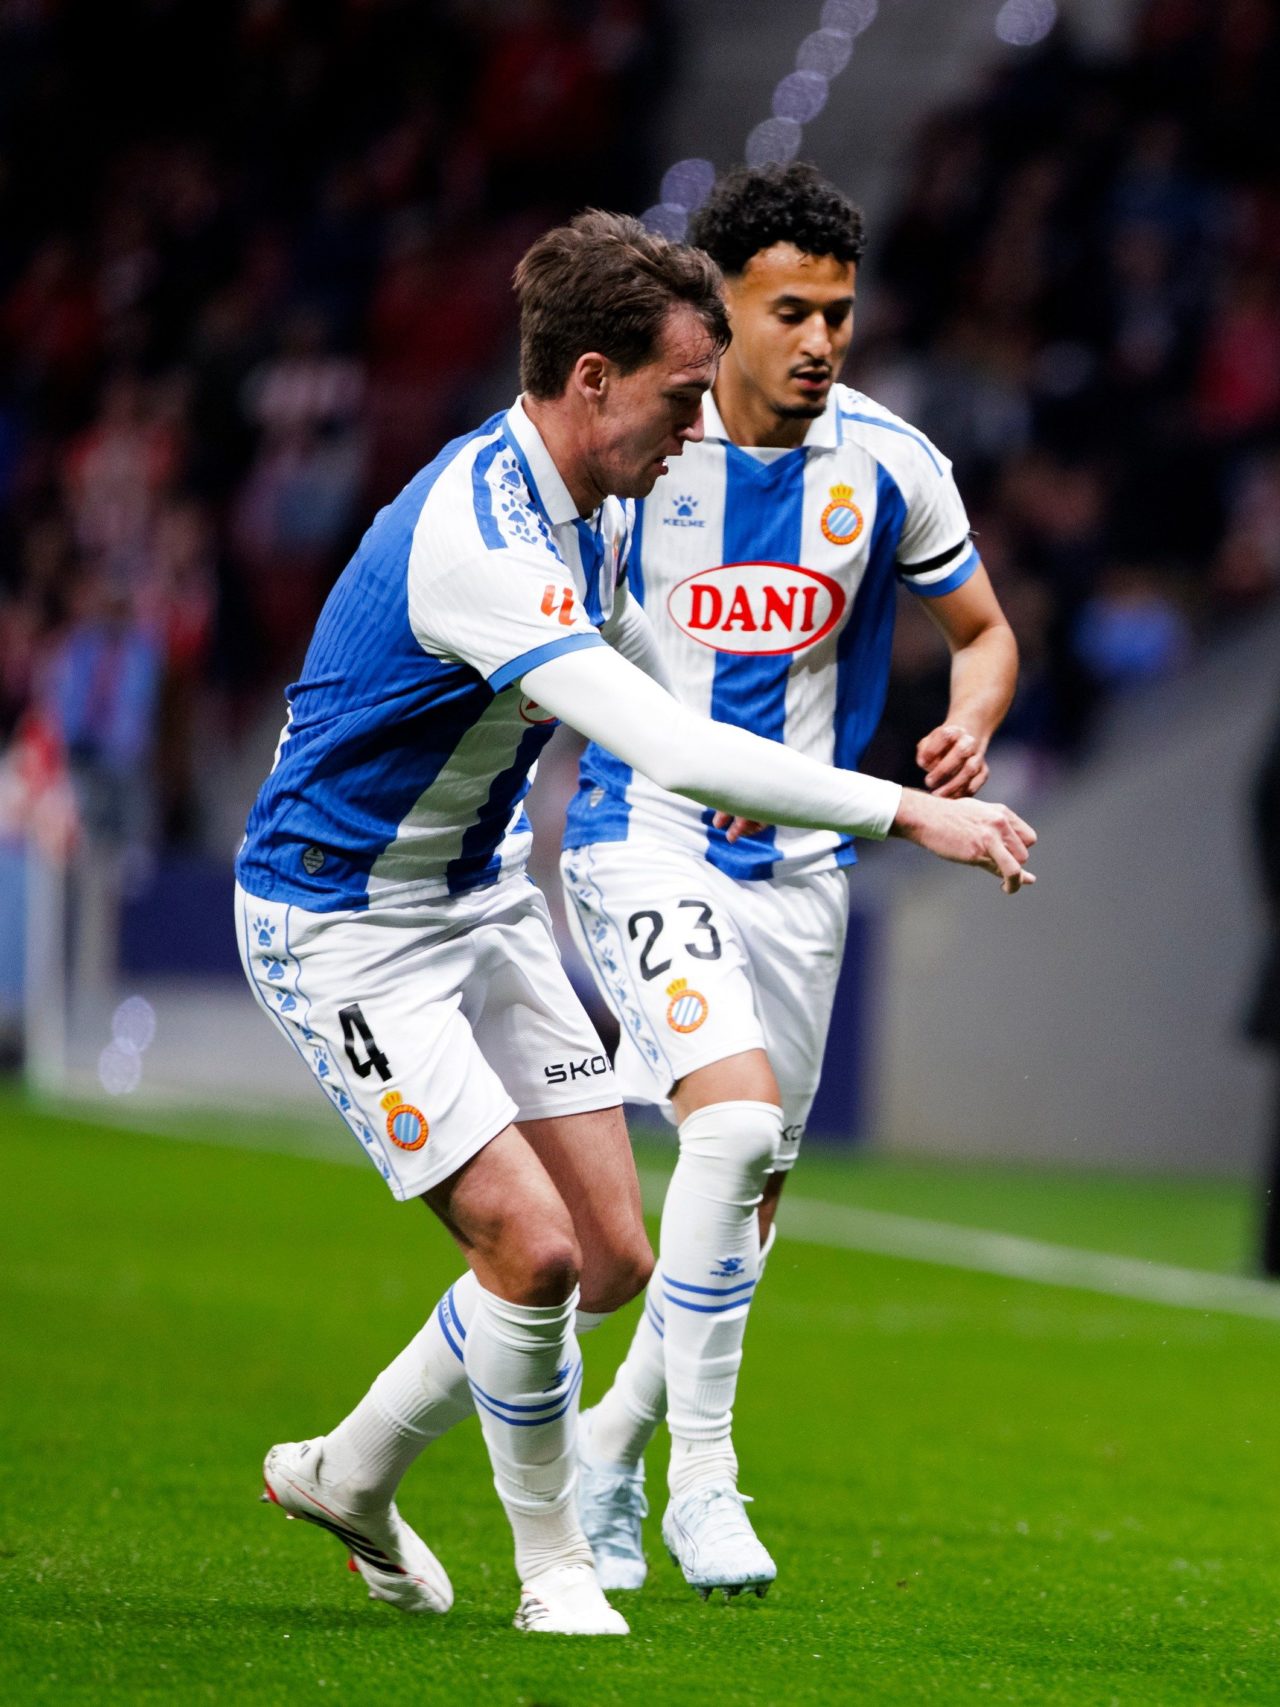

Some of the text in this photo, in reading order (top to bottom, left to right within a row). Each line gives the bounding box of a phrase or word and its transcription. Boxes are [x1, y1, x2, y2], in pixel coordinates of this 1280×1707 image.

[688, 584, 819, 632] DANI
[627, 899, 722, 982] 23
[338, 1002, 393, 1083] 4
[544, 1055, 615, 1085] SKO
